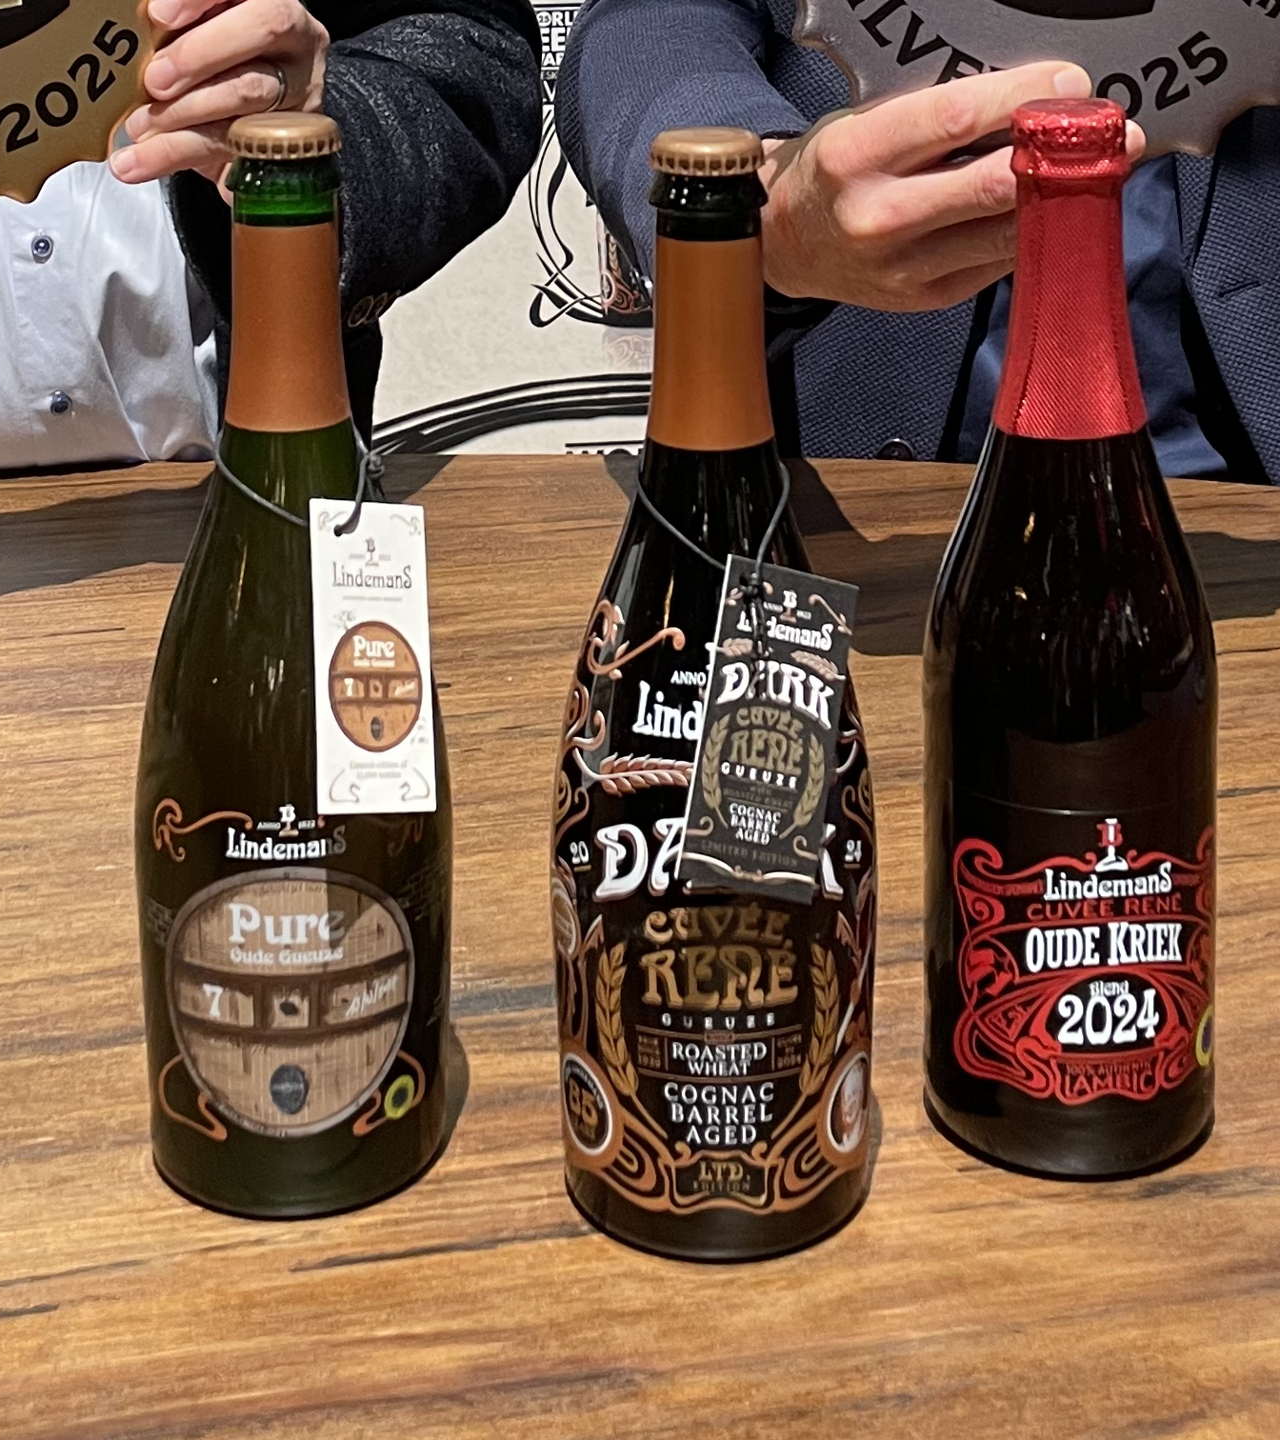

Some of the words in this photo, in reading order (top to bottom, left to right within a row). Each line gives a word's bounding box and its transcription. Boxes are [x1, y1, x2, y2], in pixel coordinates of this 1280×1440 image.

[1096, 30, 1229, 122] 025
[352, 635, 395, 658] Pure
[670, 671, 706, 686] ANNO
[721, 761, 797, 789] GUEUZE
[729, 803, 781, 823] COGNAC
[730, 814, 778, 836] BARREL
[735, 828, 770, 845] AGED
[570, 841, 589, 864] 20
[227, 903, 345, 945] Pure
[230, 947, 273, 963] Oude
[1025, 926, 1100, 973] OUDE
[1108, 922, 1183, 966] KRIEK
[1089, 980, 1129, 996] Blend
[203, 984, 224, 1016] 7
[1057, 989, 1160, 1045] 2024
[672, 1042, 767, 1061] ROASTED
[688, 1061, 750, 1076] WHEAT
[664, 1082, 774, 1104] COGNAC
[671, 1103, 773, 1126] BARREL
[686, 1125, 757, 1145] AGED
